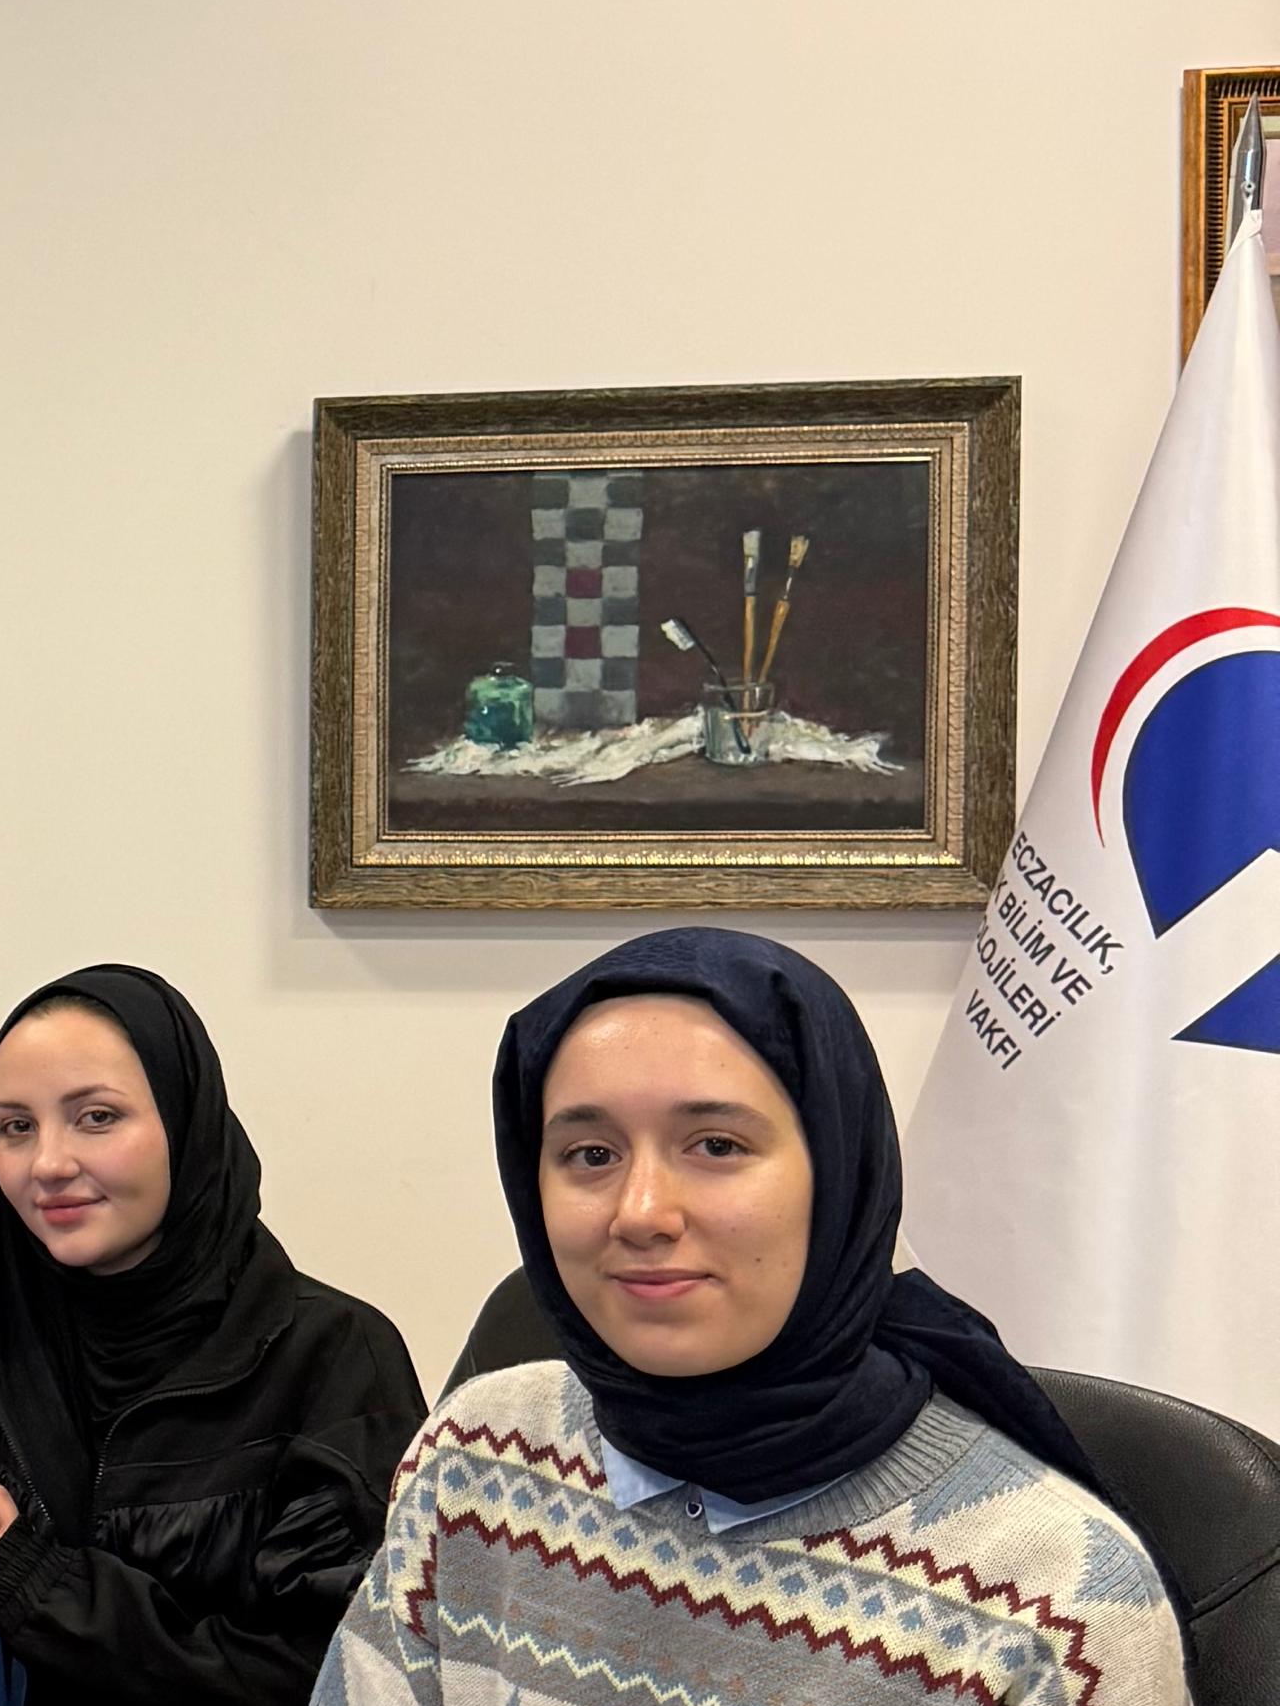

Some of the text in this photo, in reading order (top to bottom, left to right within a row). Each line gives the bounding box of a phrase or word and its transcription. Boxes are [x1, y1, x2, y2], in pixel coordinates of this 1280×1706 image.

[998, 891, 1093, 1005] BİLİM VE
[1011, 831, 1125, 975] ECZACILIK,
[965, 989, 1022, 1070] VAKFI
[976, 917, 1062, 1037] LOJİLERİ
